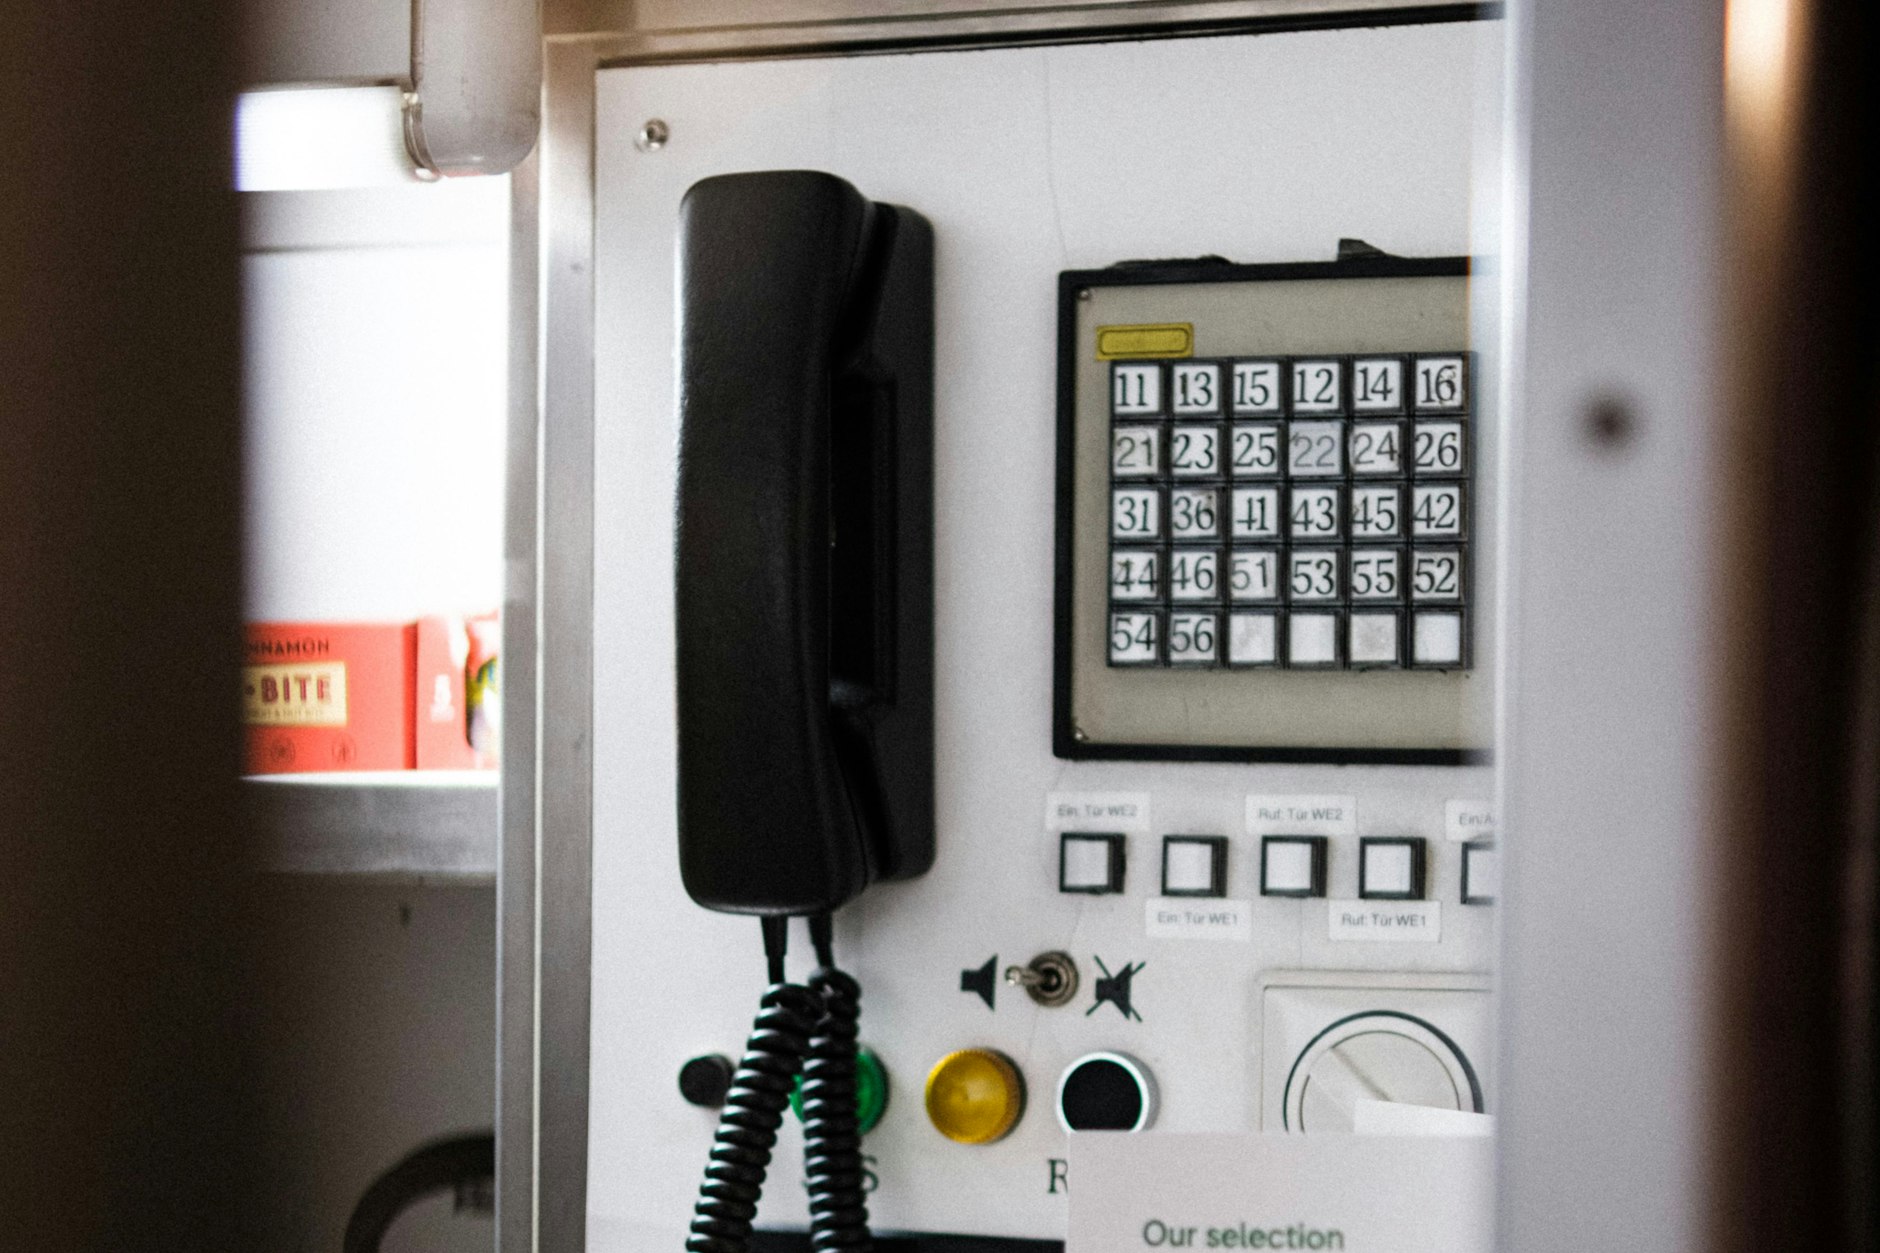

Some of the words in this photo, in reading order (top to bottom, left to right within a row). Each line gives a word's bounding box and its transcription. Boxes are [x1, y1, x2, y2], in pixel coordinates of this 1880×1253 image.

[1117, 373, 1146, 407] 11
[1178, 372, 1212, 407] 13
[1236, 371, 1269, 406] 15
[1296, 369, 1334, 404] 12
[1357, 367, 1392, 401] 14
[1421, 365, 1456, 405] 16
[1116, 436, 1153, 468] 21
[1173, 433, 1215, 468] 23
[1234, 433, 1276, 467] 25
[1293, 436, 1335, 467] 22
[1353, 432, 1397, 465] 24
[1414, 432, 1458, 467] 26
[1118, 497, 1151, 532] 31
[1174, 497, 1215, 530] 36
[1237, 497, 1269, 531] 41
[1291, 496, 1334, 531] 43
[1352, 496, 1396, 531] 45
[1412, 494, 1456, 529] 42
[1113, 560, 1158, 592] 44
[1172, 556, 1213, 590] 46
[1231, 559, 1268, 590] 51
[1292, 560, 1334, 595] 53
[1352, 559, 1395, 594] 55
[1414, 558, 1456, 593] 52
[243, 638, 329, 655] NNAMON
[1113, 617, 1156, 651] 54
[1171, 618, 1213, 652] 56
[1108, 805, 1138, 817] WE2
[1313, 809, 1343, 821] WE2
[1209, 913, 1237, 924] WE1
[1396, 915, 1426, 927] WE1
[1143, 1219, 1198, 1247] Our
[1206, 1222, 1345, 1250] selection
